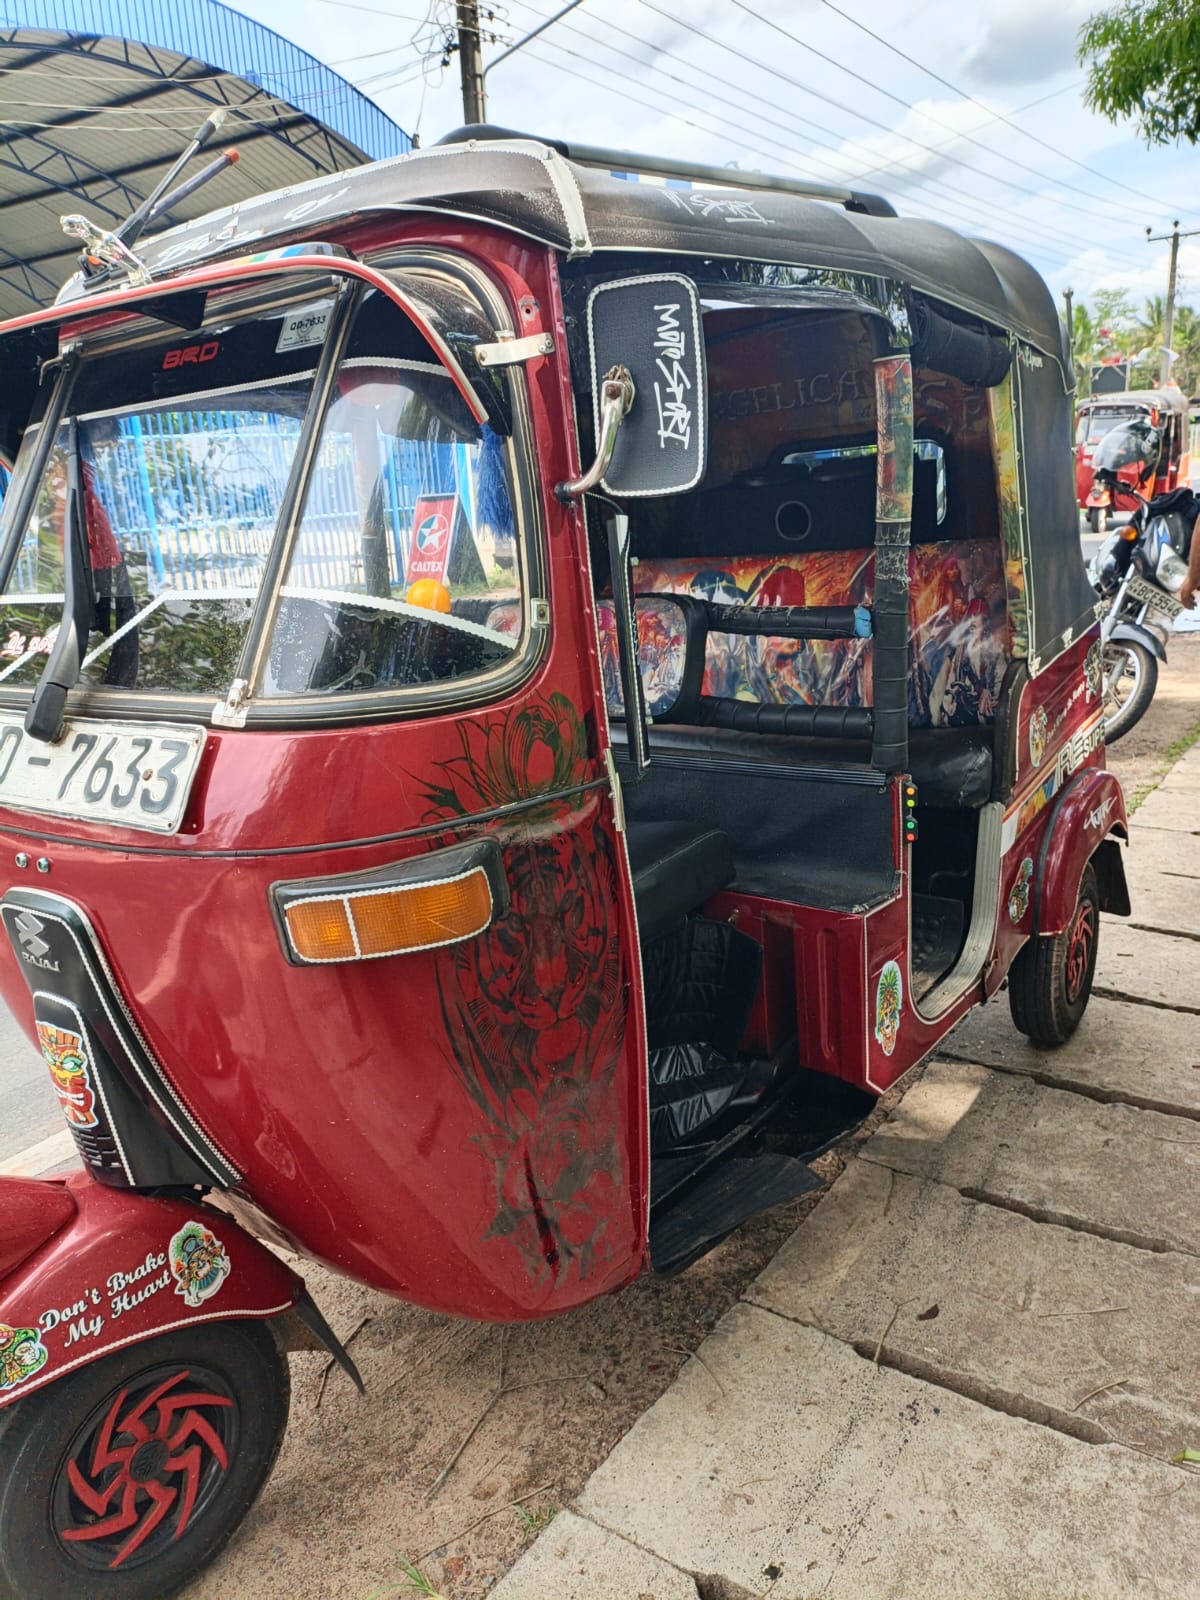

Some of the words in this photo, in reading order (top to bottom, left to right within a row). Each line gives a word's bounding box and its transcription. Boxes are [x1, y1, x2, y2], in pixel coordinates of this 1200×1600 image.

[410, 561, 443, 572] CALTEX
[22, 951, 61, 972] BAJAJ
[38, 1288, 102, 1334] Don't
[106, 1252, 168, 1297] Brake
[63, 1315, 105, 1348] My
[111, 1268, 172, 1319] Huart
